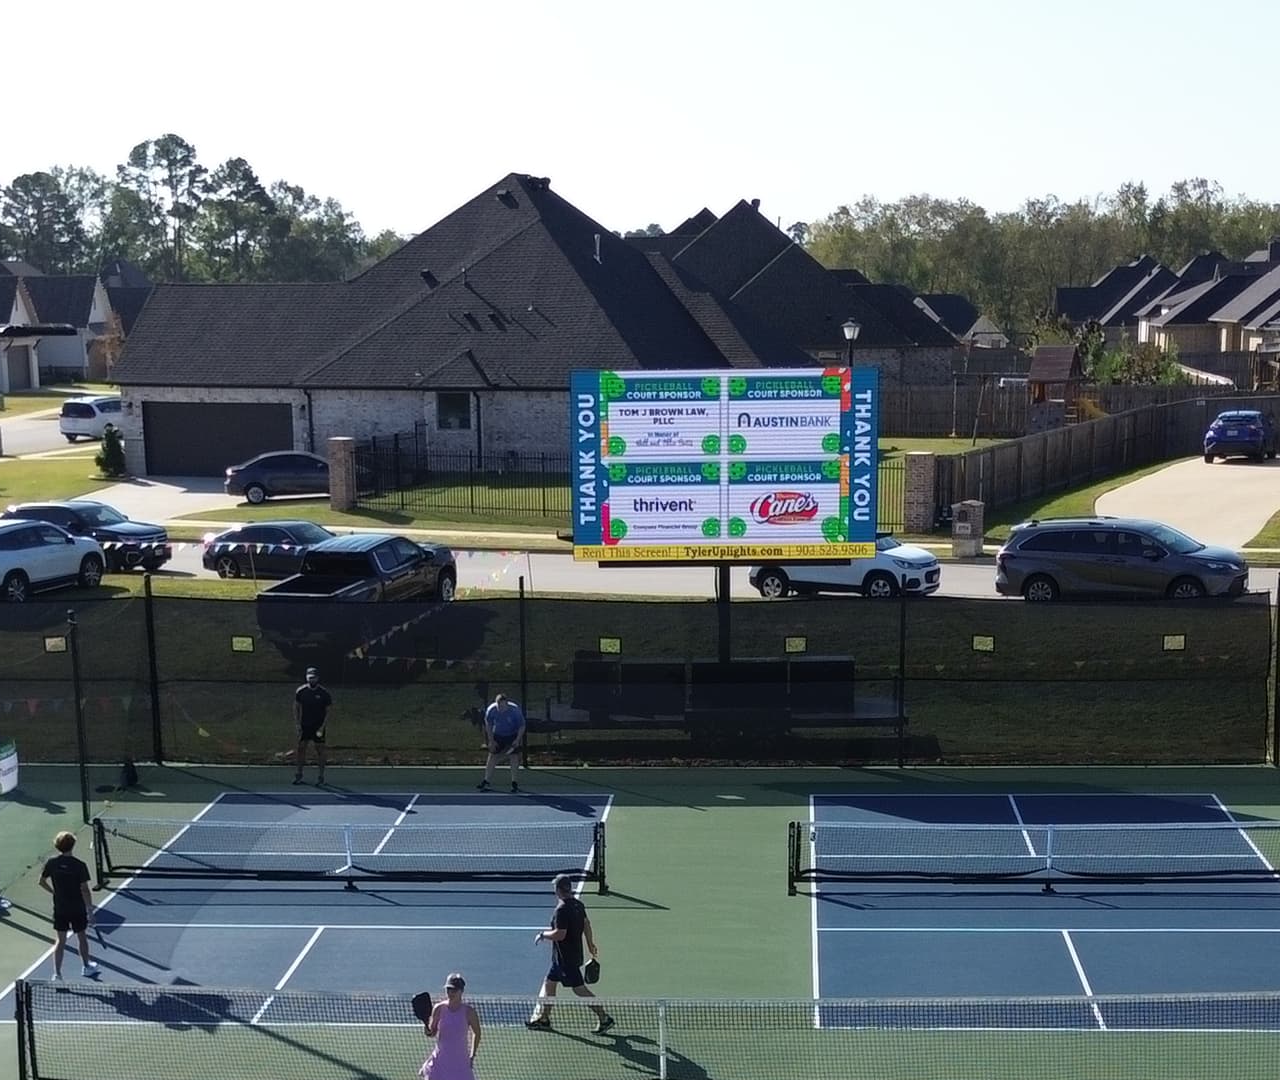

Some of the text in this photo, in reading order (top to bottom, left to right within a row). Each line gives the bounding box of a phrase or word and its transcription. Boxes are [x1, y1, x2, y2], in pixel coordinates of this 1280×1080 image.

[626, 391, 702, 400] COURT SPONSOR
[747, 389, 822, 398] COURT SPONSOR
[619, 408, 639, 417] TOM
[649, 408, 684, 417] BROWN
[685, 407, 709, 417] LAW,
[652, 417, 675, 425] PLLC
[578, 394, 596, 526] THANK YOU
[853, 390, 872, 522] THANK YOU
[627, 474, 702, 484] COURT SPONSOR
[747, 473, 822, 482] COURT SPONSOR
[633, 497, 694, 512] thrivent
[751, 492, 819, 524] Cane's
[582, 547, 607, 559] Rent
[609, 546, 631, 558] This
[632, 546, 671, 558] Screen!
[684, 545, 783, 559] TylerUplights.com
